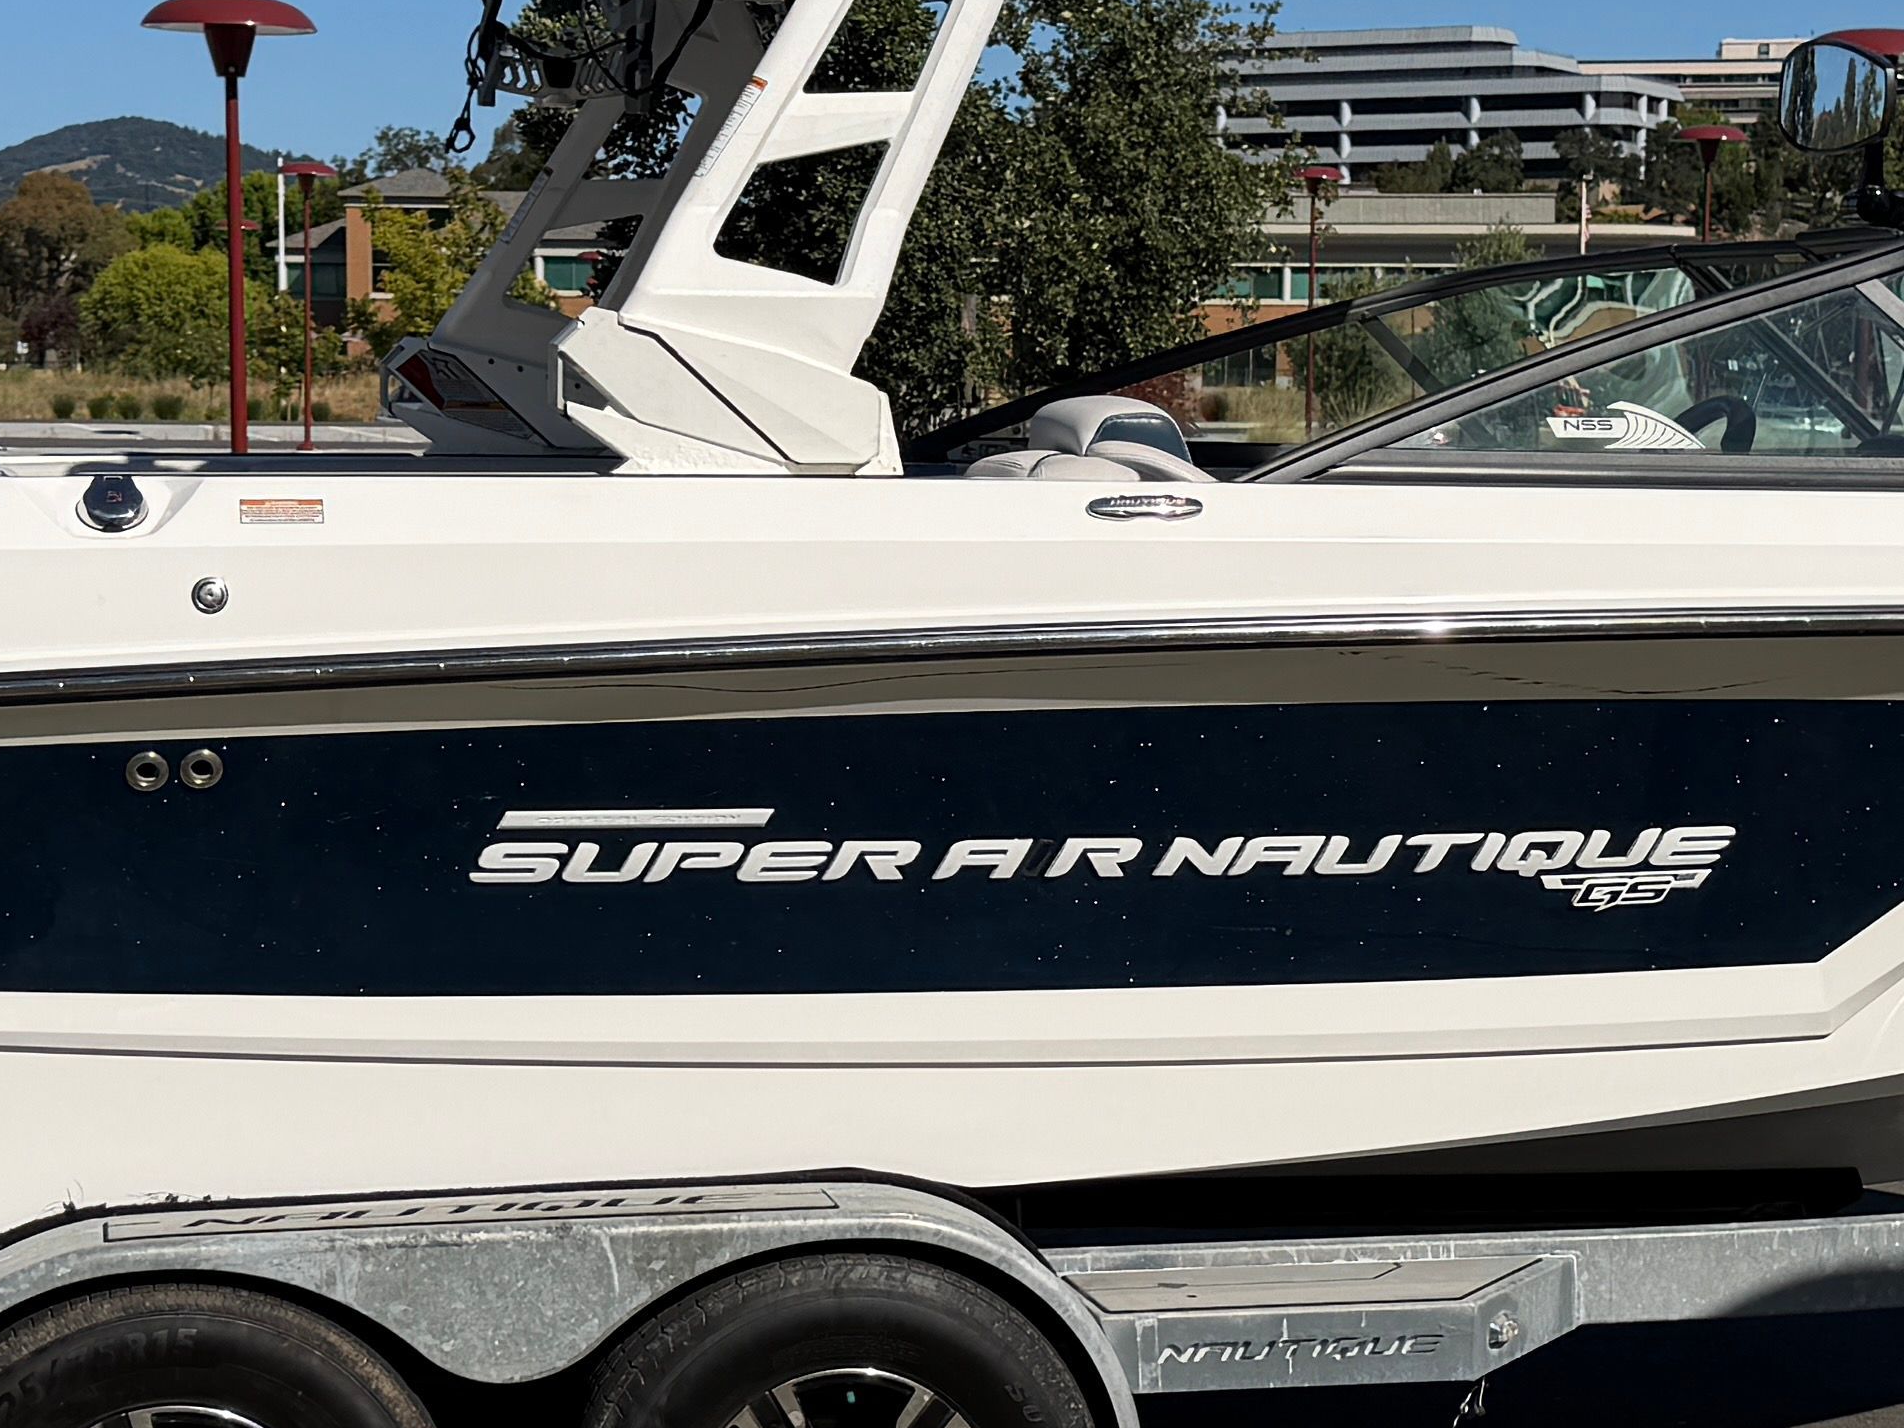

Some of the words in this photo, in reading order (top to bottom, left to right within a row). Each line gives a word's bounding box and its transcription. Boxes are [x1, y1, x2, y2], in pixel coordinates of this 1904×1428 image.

[1563, 419, 1613, 431] NSS
[470, 840, 922, 883] SUPER
[1151, 826, 1737, 878] NAUTIQUE
[1573, 876, 1676, 912] GS
[1157, 1333, 1445, 1365] NAUTIQUE
